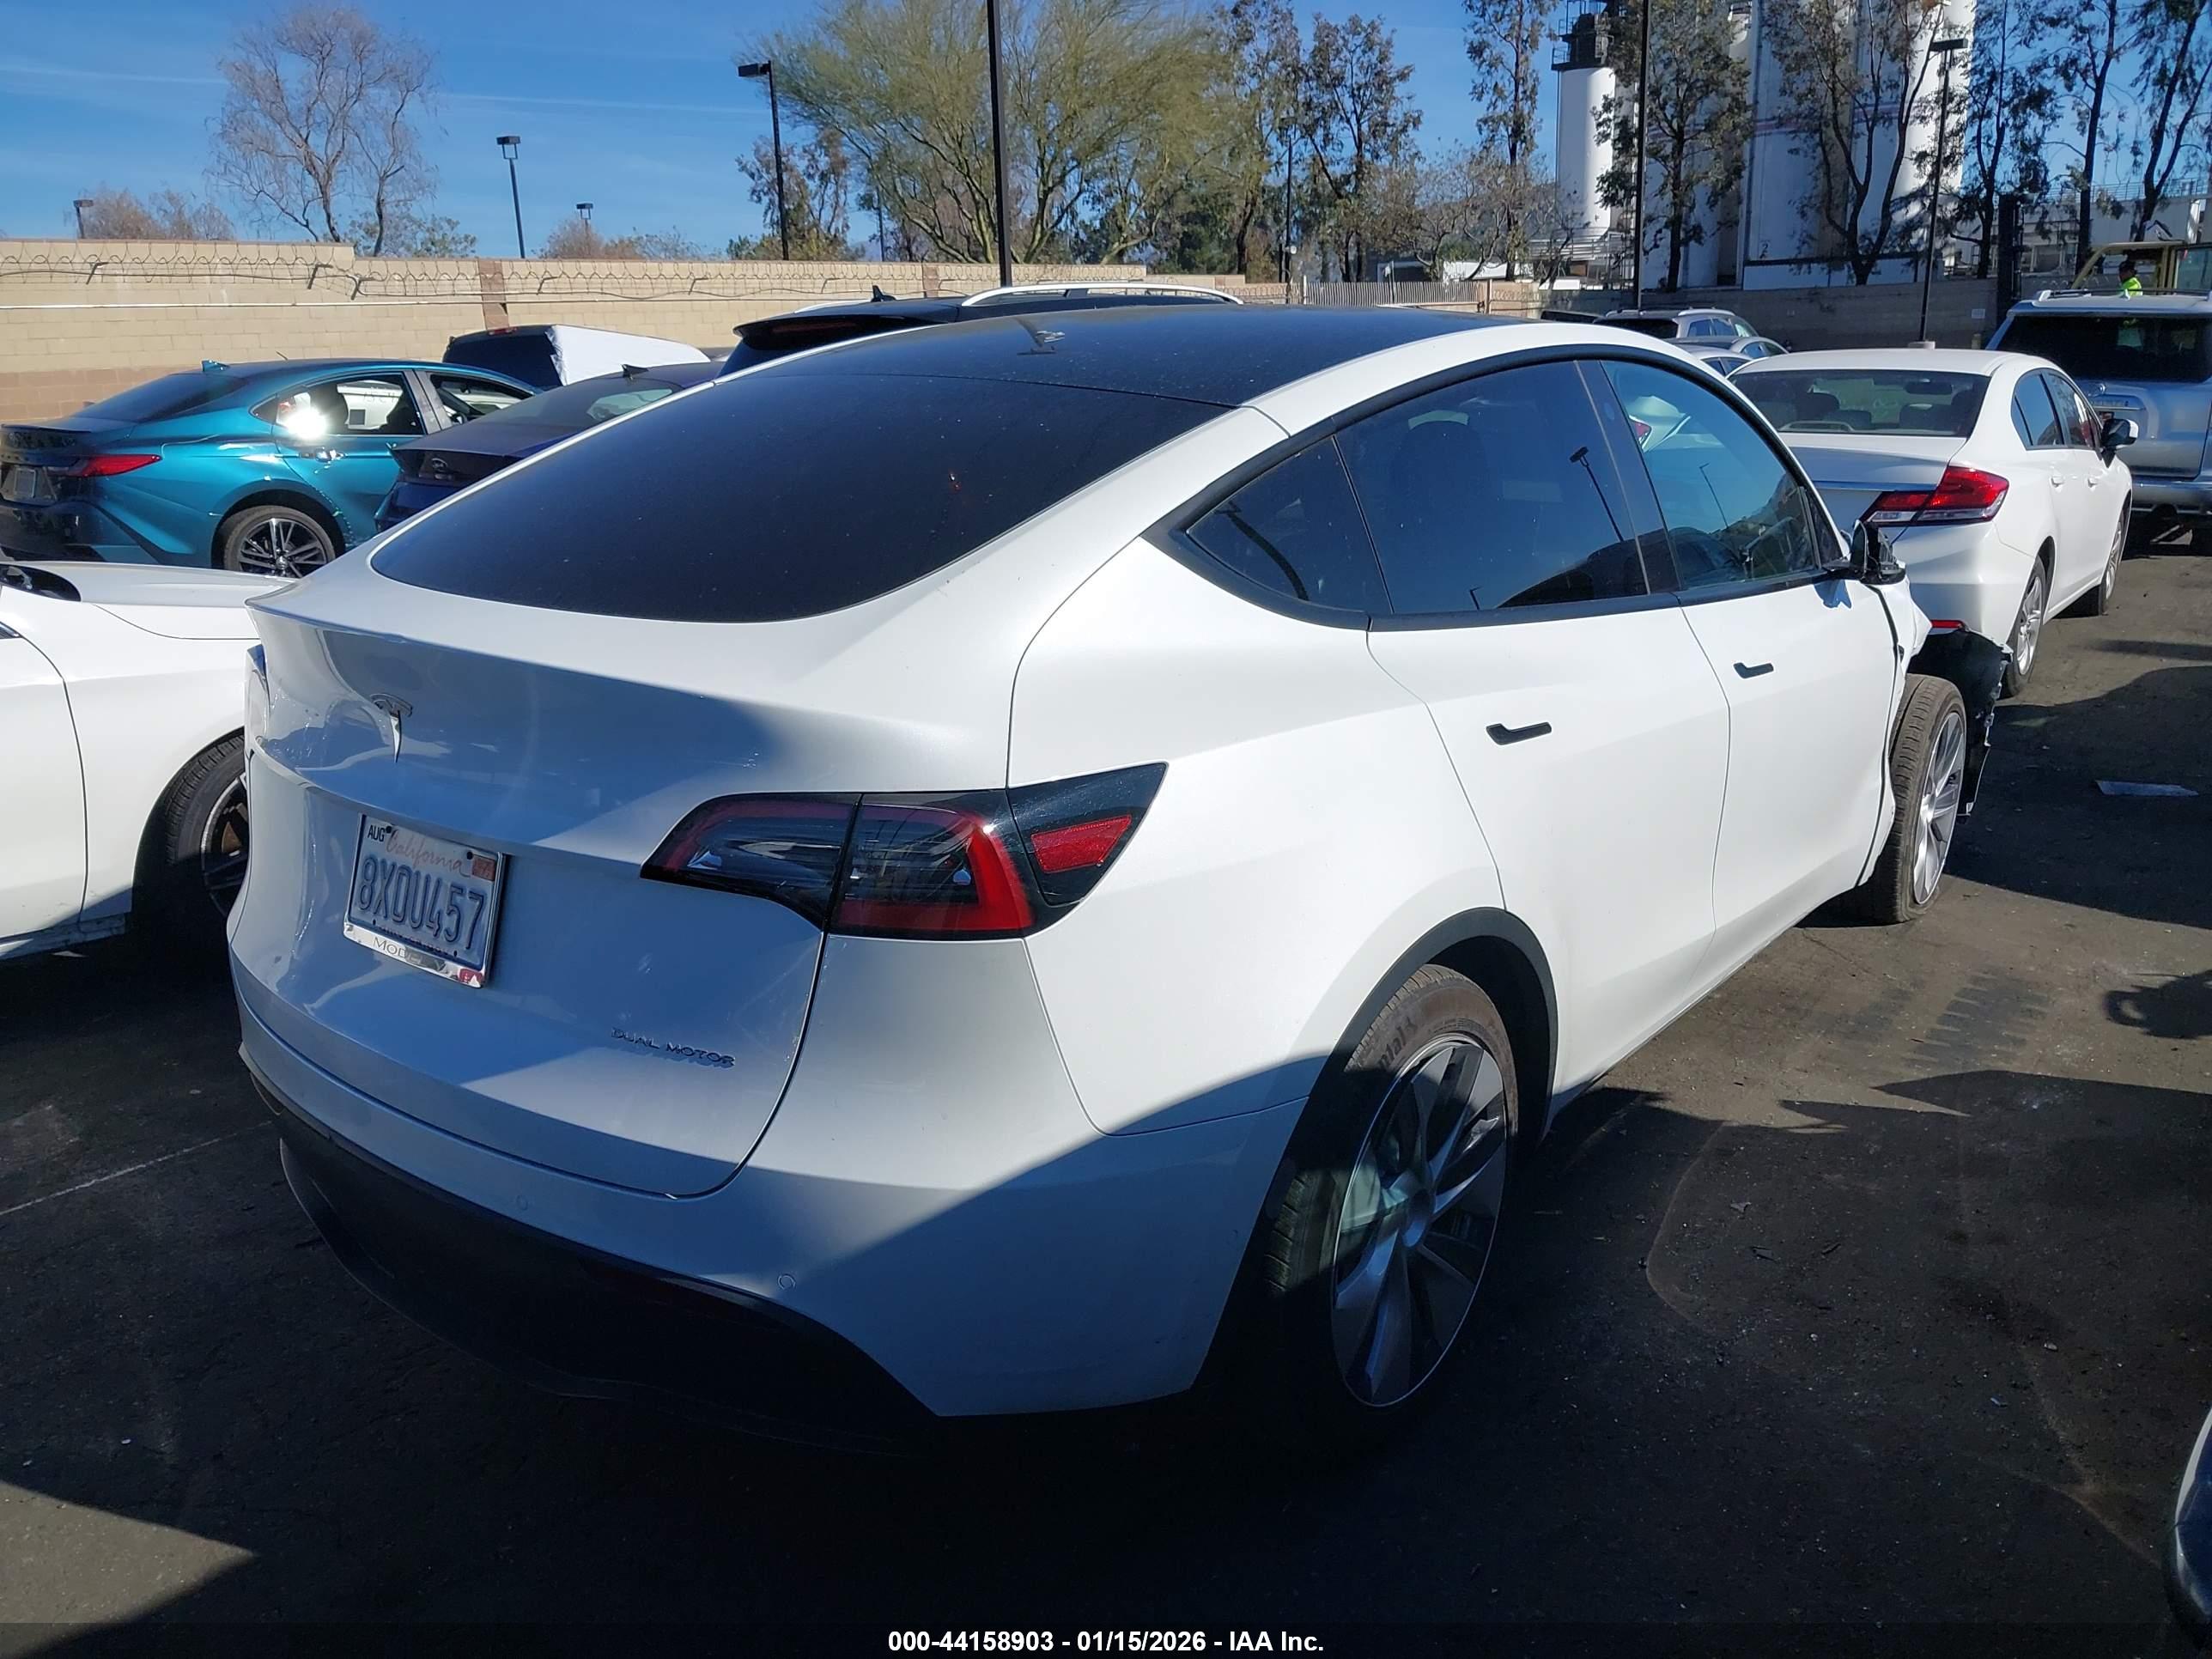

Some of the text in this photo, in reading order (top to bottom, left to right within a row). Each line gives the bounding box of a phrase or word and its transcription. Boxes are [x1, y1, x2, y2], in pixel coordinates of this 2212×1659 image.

[367, 824, 386, 842] AUG
[386, 829, 471, 878] California
[611, 1028, 736, 1066] DUAL MOTOR
